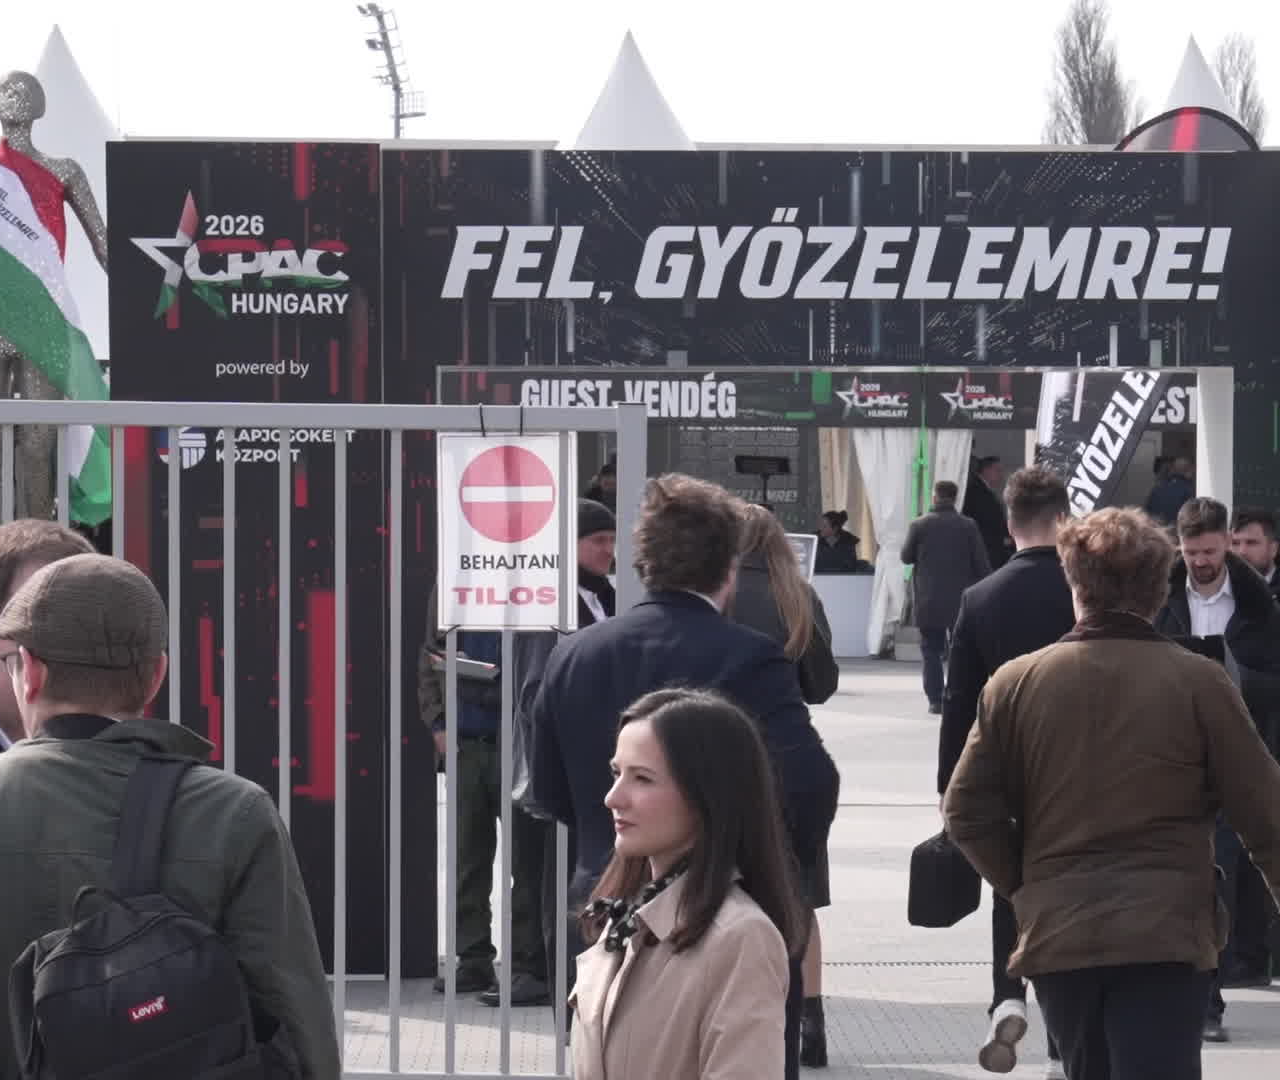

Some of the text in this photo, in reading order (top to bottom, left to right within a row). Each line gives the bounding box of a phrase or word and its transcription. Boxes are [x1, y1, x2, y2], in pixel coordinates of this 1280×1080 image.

[204, 215, 265, 236] 2026
[183, 238, 350, 289] CPAC
[440, 207, 1233, 305] FEL, GYŐZELEMRE!
[231, 293, 350, 314] HUNGARY
[215, 360, 310, 378] powered by
[623, 371, 737, 418] VENDÉG
[452, 586, 557, 606] TILOS
